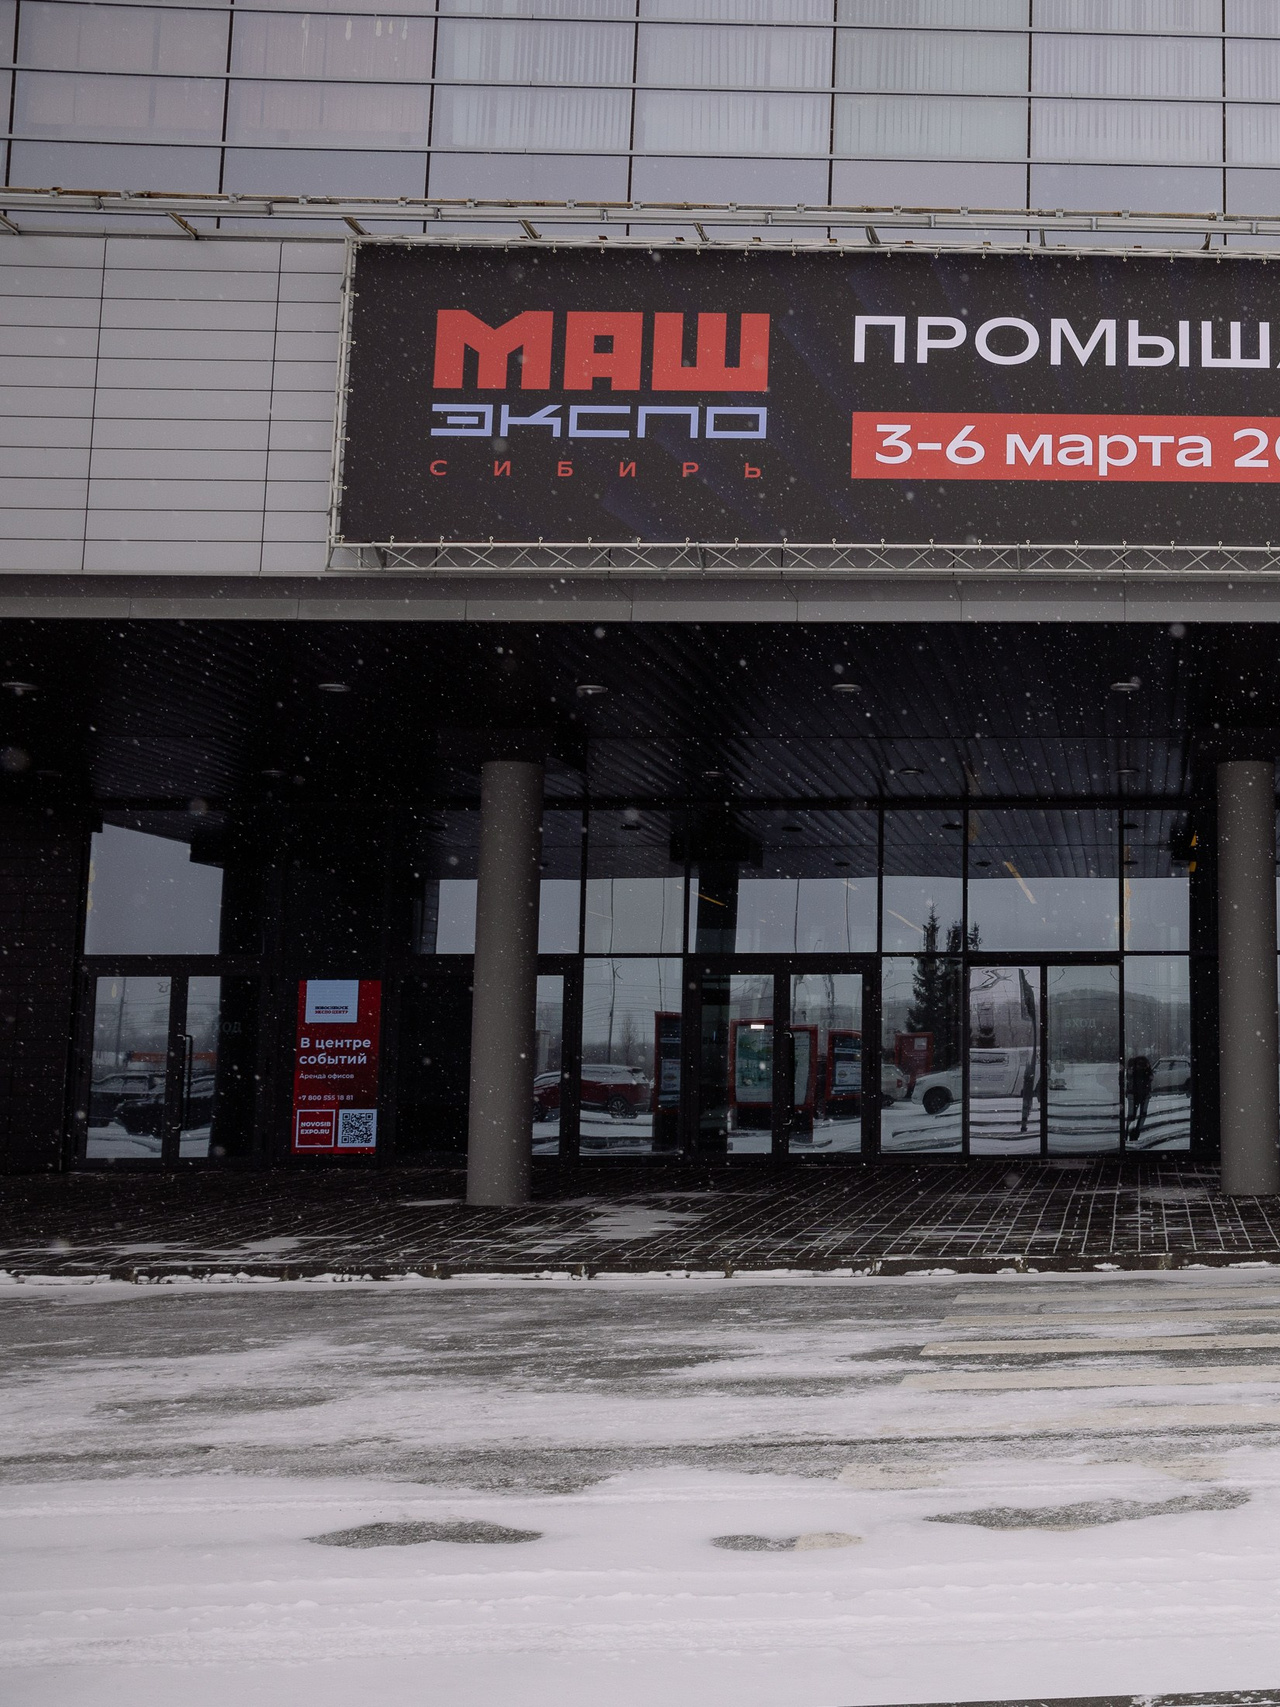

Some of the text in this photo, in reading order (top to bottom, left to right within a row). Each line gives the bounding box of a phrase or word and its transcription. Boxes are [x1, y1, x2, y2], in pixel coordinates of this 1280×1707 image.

[433, 310, 770, 393] МАШ
[430, 404, 768, 439] ЭКСПО
[875, 425, 985, 465] 3-6
[1006, 434, 1211, 476] марта
[429, 460, 763, 480] СИБИРЬ
[300, 1037, 371, 1051] В центре
[299, 1052, 367, 1065] событий
[300, 1120, 332, 1128] NOVOSIB
[300, 1128, 330, 1136] EXPO.RU
